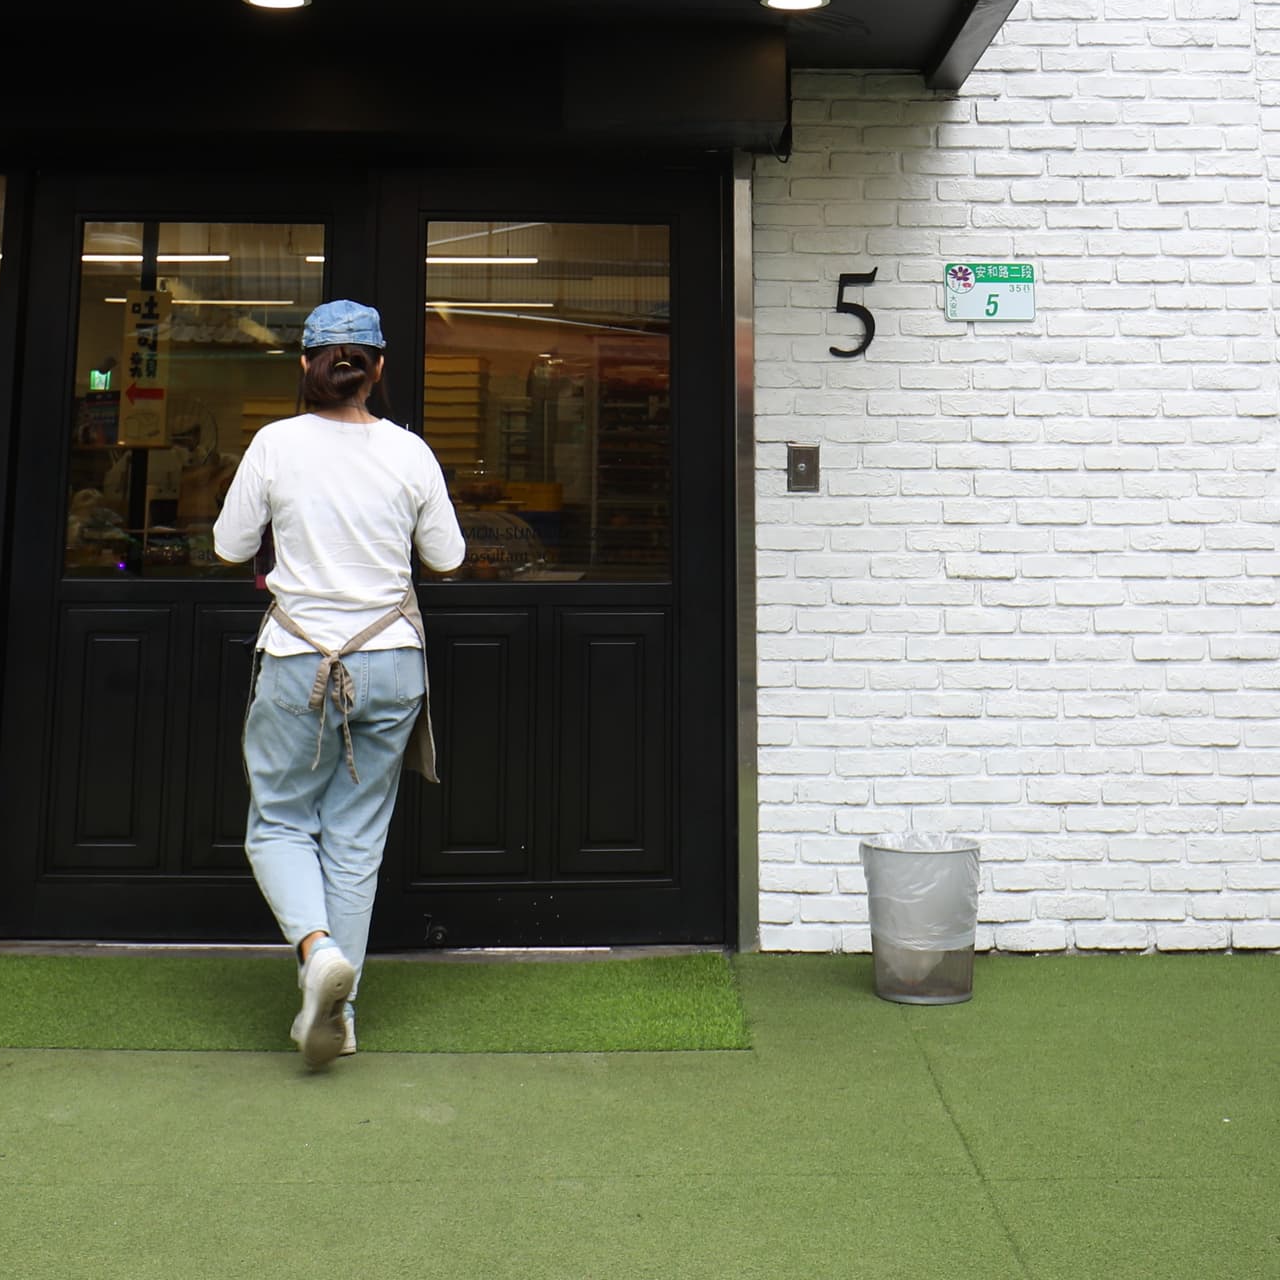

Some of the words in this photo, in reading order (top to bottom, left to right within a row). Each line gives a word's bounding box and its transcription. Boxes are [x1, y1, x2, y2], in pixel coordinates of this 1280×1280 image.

[975, 265, 1033, 279] 安和路二段
[829, 266, 878, 358] 5
[985, 293, 1000, 317] 5
